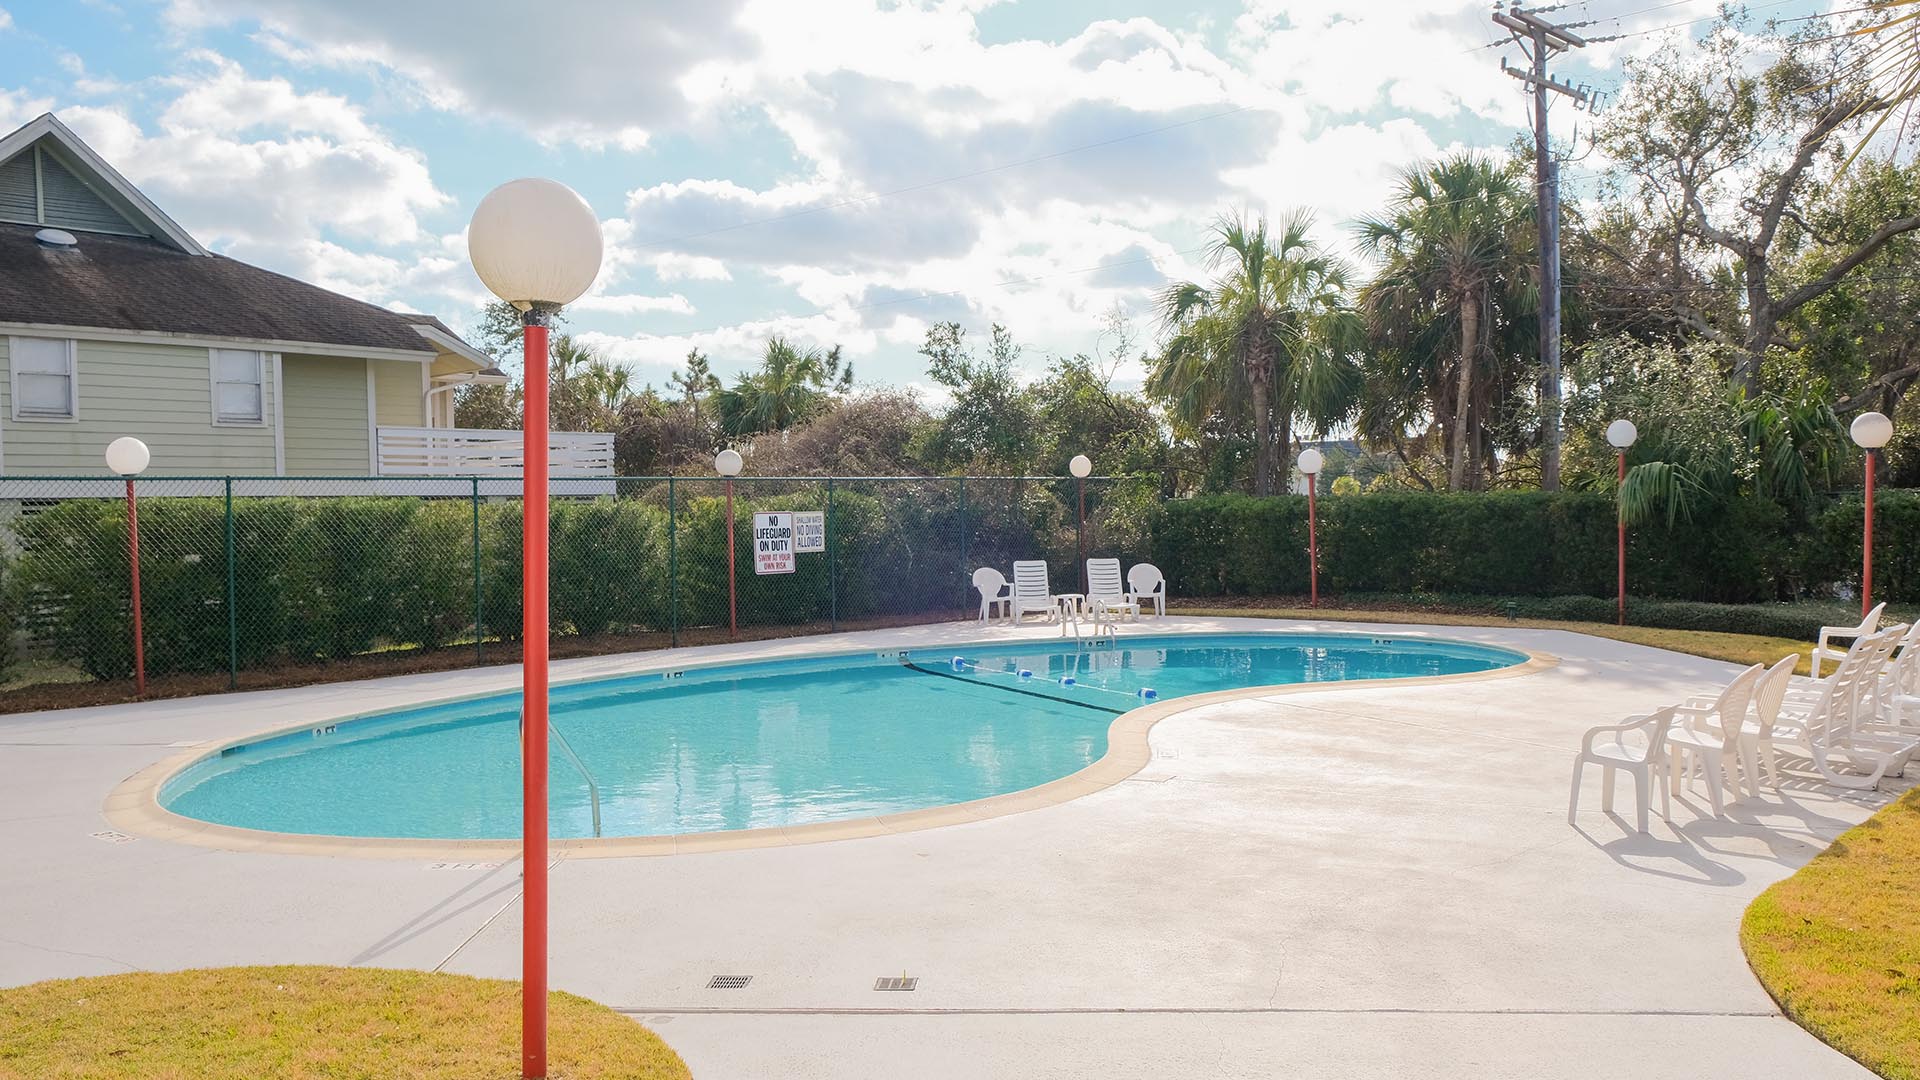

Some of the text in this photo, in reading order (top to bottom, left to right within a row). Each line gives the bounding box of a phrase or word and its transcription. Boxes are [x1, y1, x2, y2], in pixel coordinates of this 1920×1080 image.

[769, 516, 778, 526] NO
[756, 528, 790, 540] LIFEGUARD
[796, 524, 822, 536] NO DIVING
[760, 540, 788, 552] ON DUTY
[798, 536, 822, 548] ALLOWED
[758, 554, 771, 562] SWIM
